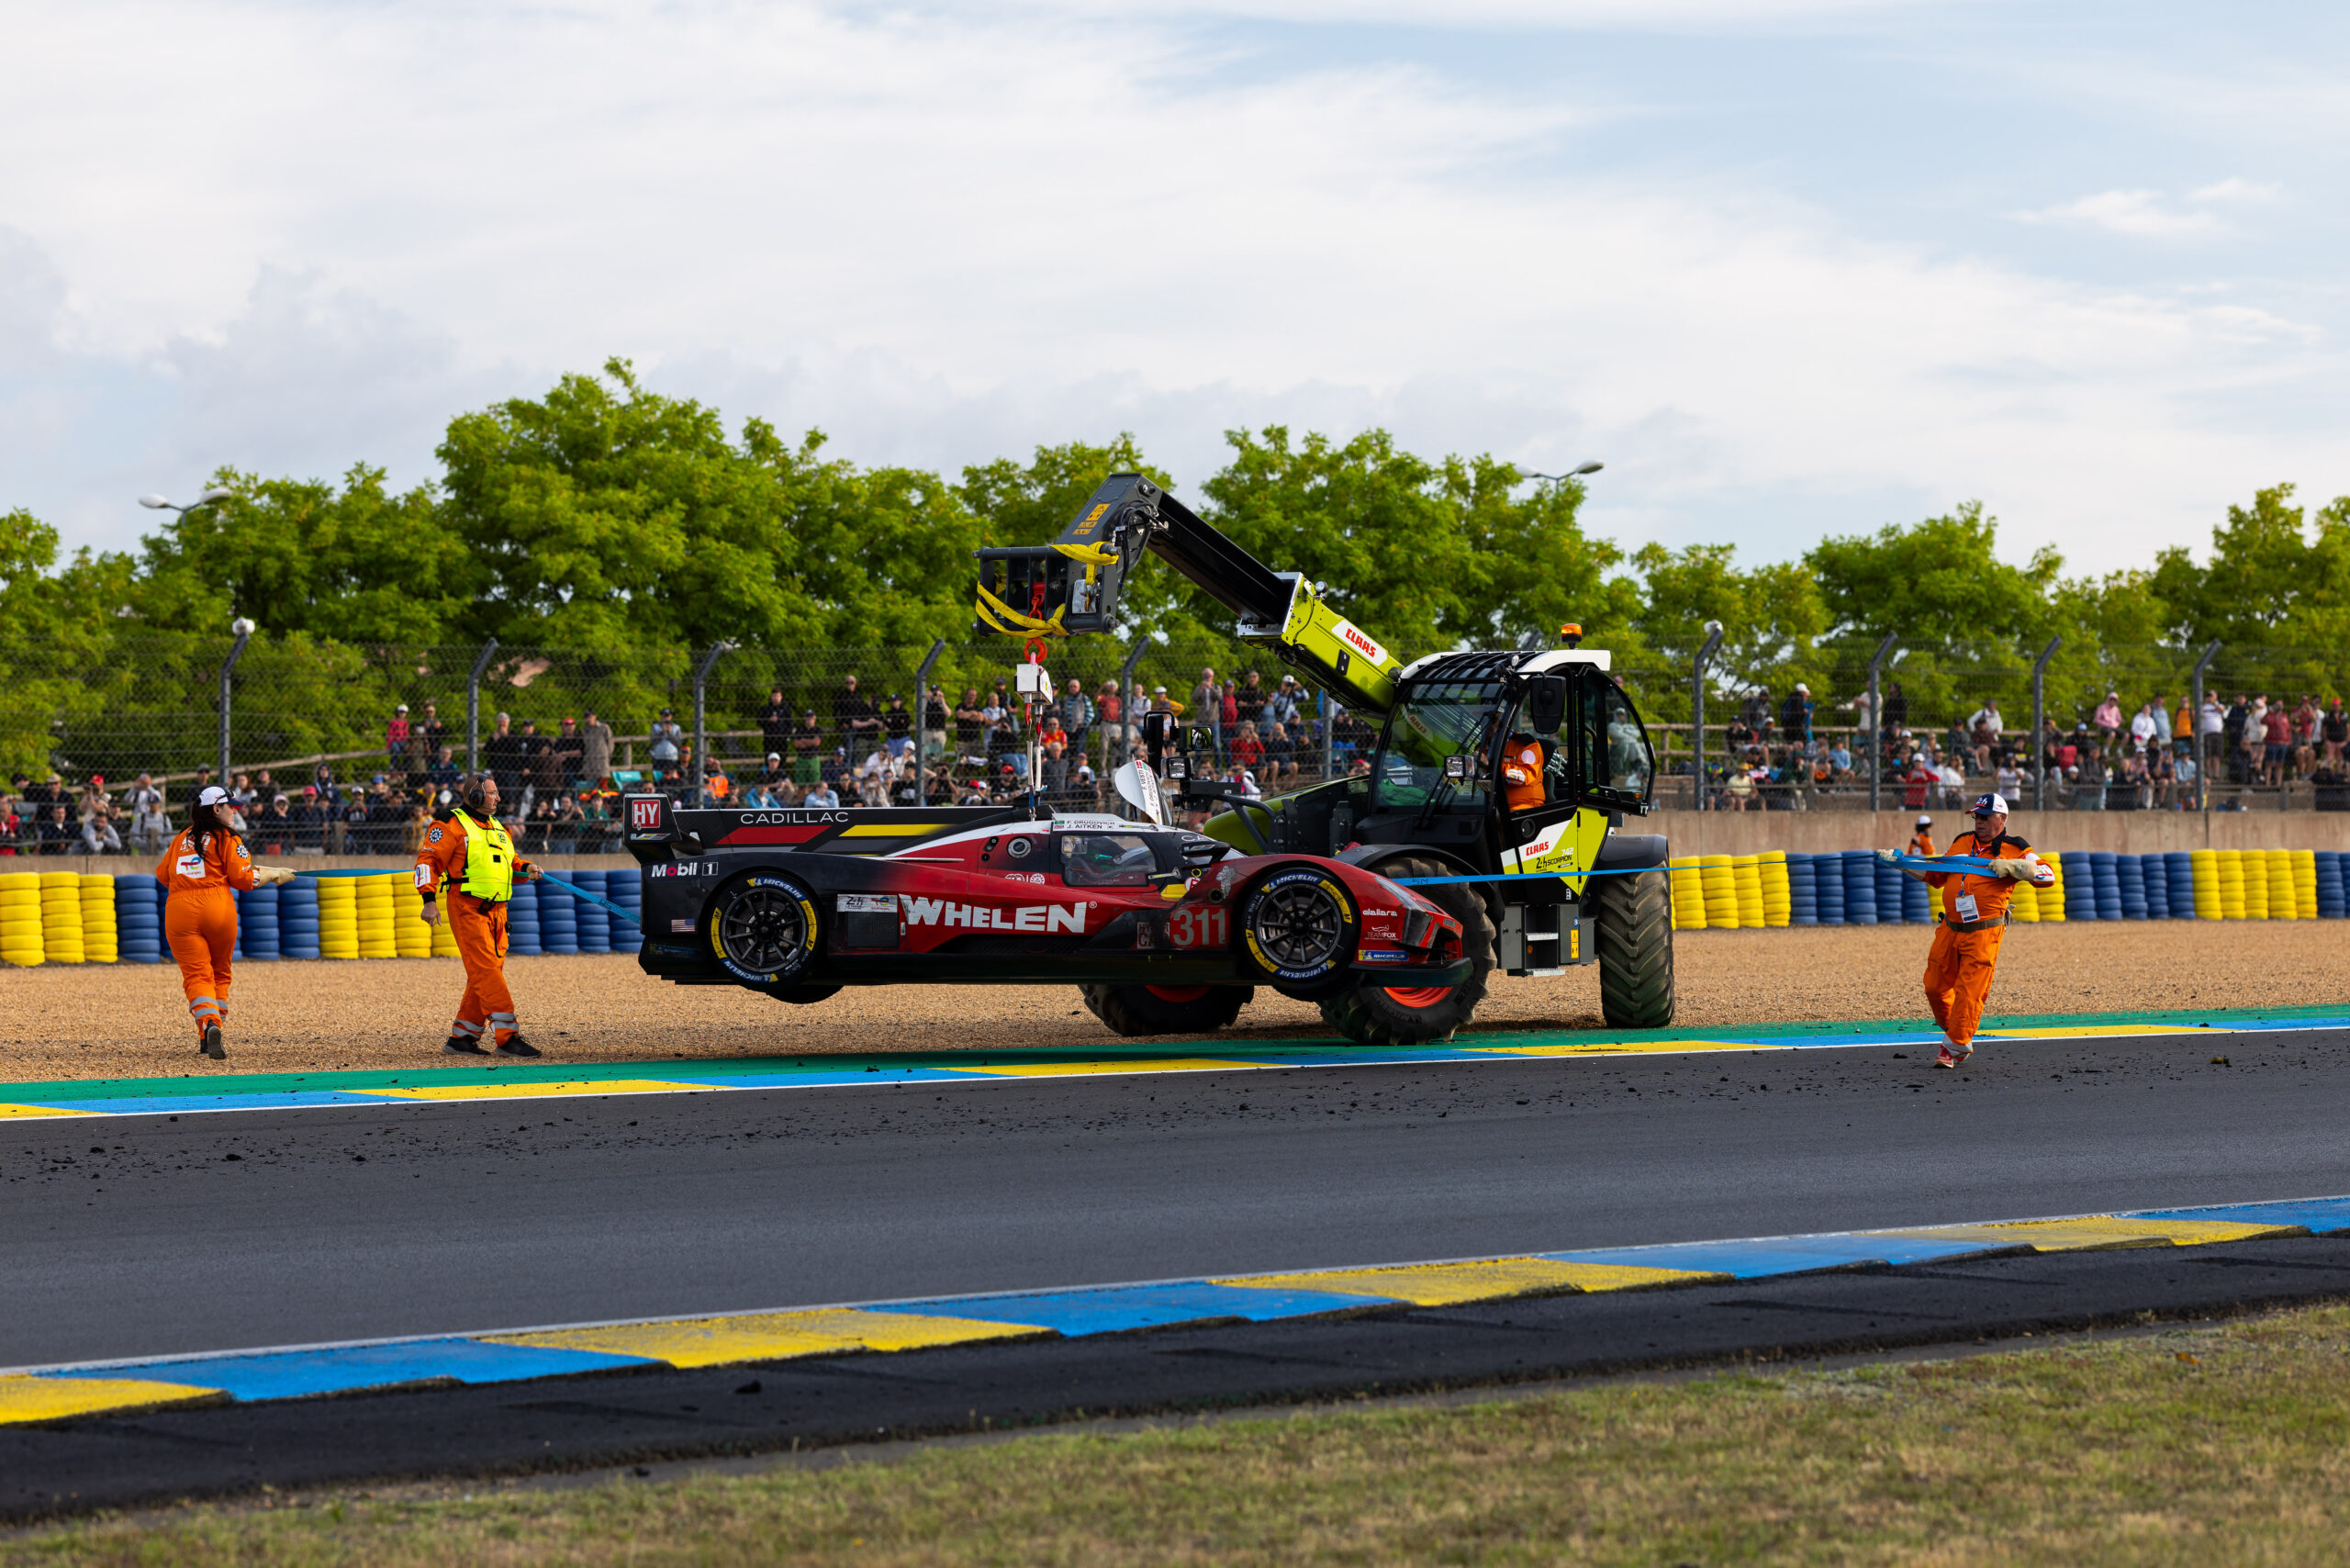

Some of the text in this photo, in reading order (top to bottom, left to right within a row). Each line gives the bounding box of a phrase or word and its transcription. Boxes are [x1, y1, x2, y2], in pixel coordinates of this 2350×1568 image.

[1345, 627, 1376, 658] CLAAS
[633, 803, 658, 824] HY
[740, 812, 849, 824] CADILLAC
[1526, 841, 1550, 857] CLAAS
[1561, 846, 1574, 857] 742
[1548, 854, 1572, 867] SCORPION
[651, 862, 698, 878] Mobil
[1276, 874, 1319, 885] MICHELIN
[764, 878, 803, 899] MICHELIN
[899, 893, 1087, 934] WHELEN
[1362, 908, 1397, 916] dallara
[1173, 909, 1226, 946] 311
[723, 960, 762, 981] MICHELIN
[1279, 968, 1321, 979] MICHELIN
